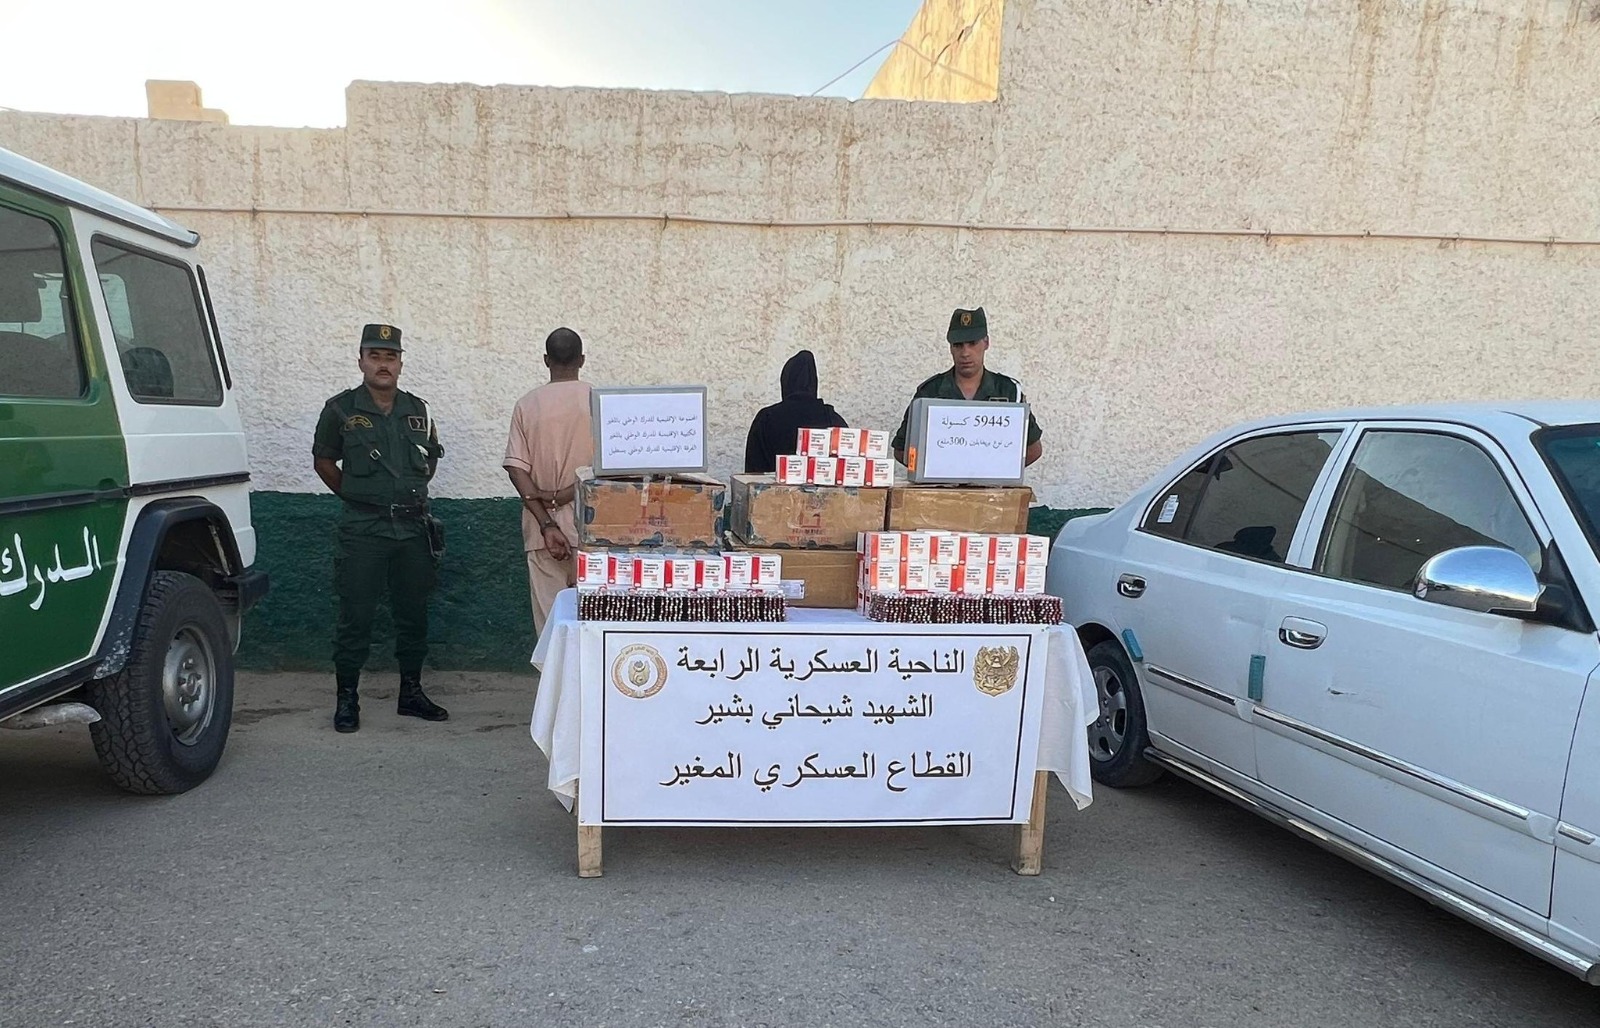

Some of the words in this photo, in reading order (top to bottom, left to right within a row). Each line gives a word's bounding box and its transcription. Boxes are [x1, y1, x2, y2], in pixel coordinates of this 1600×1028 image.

[973, 415, 1010, 427] 59445
[0, 526, 102, 610] الدرك
[676, 646, 760, 679] الرابعة
[769, 647, 878, 680] العسكرية
[887, 647, 965, 680] الناحية
[695, 693, 754, 725] بشير
[761, 693, 853, 729] شيحاني
[862, 693, 933, 725] الشهيد
[659, 751, 742, 787] المغير
[753, 751, 875, 792] العسكري
[886, 751, 972, 791] القطاع
